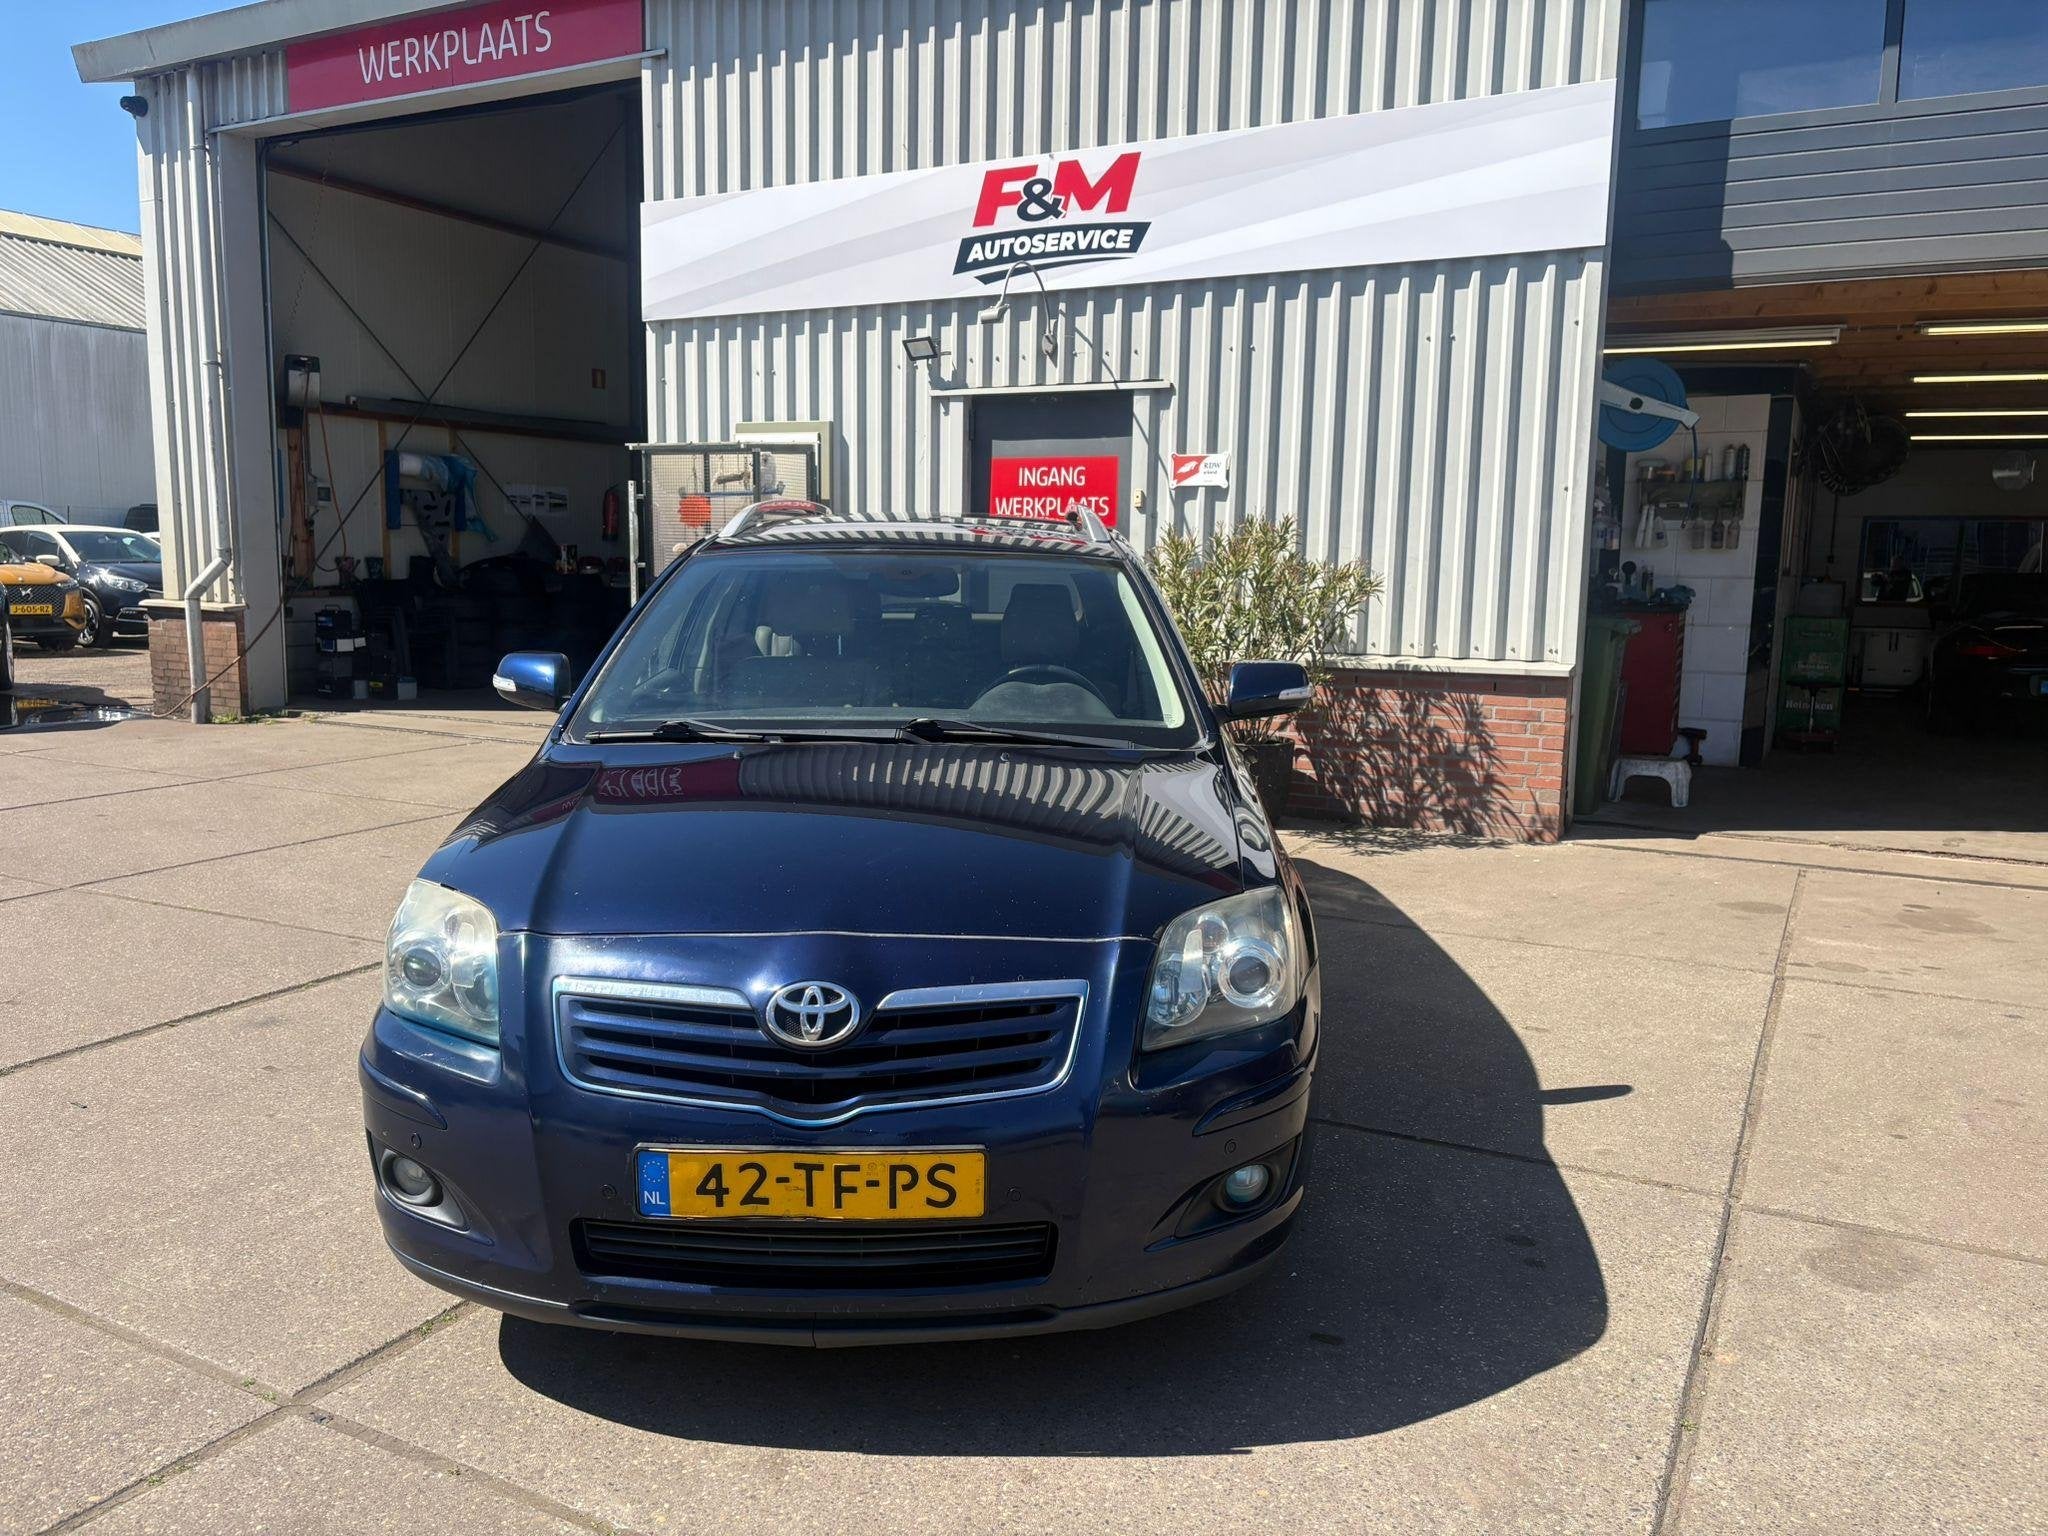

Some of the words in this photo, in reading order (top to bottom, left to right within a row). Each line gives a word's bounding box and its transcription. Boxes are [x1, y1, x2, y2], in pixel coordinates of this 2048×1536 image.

[358, 10, 551, 84] WERKPLAATS
[972, 151, 1142, 228] F&M
[966, 228, 1134, 263] AUTOSERVICE
[1018, 466, 1086, 487] INGANG
[1785, 699, 1833, 711] Heinken
[643, 1190, 666, 1206] NL
[695, 1162, 958, 1210] 42-TF-PS
